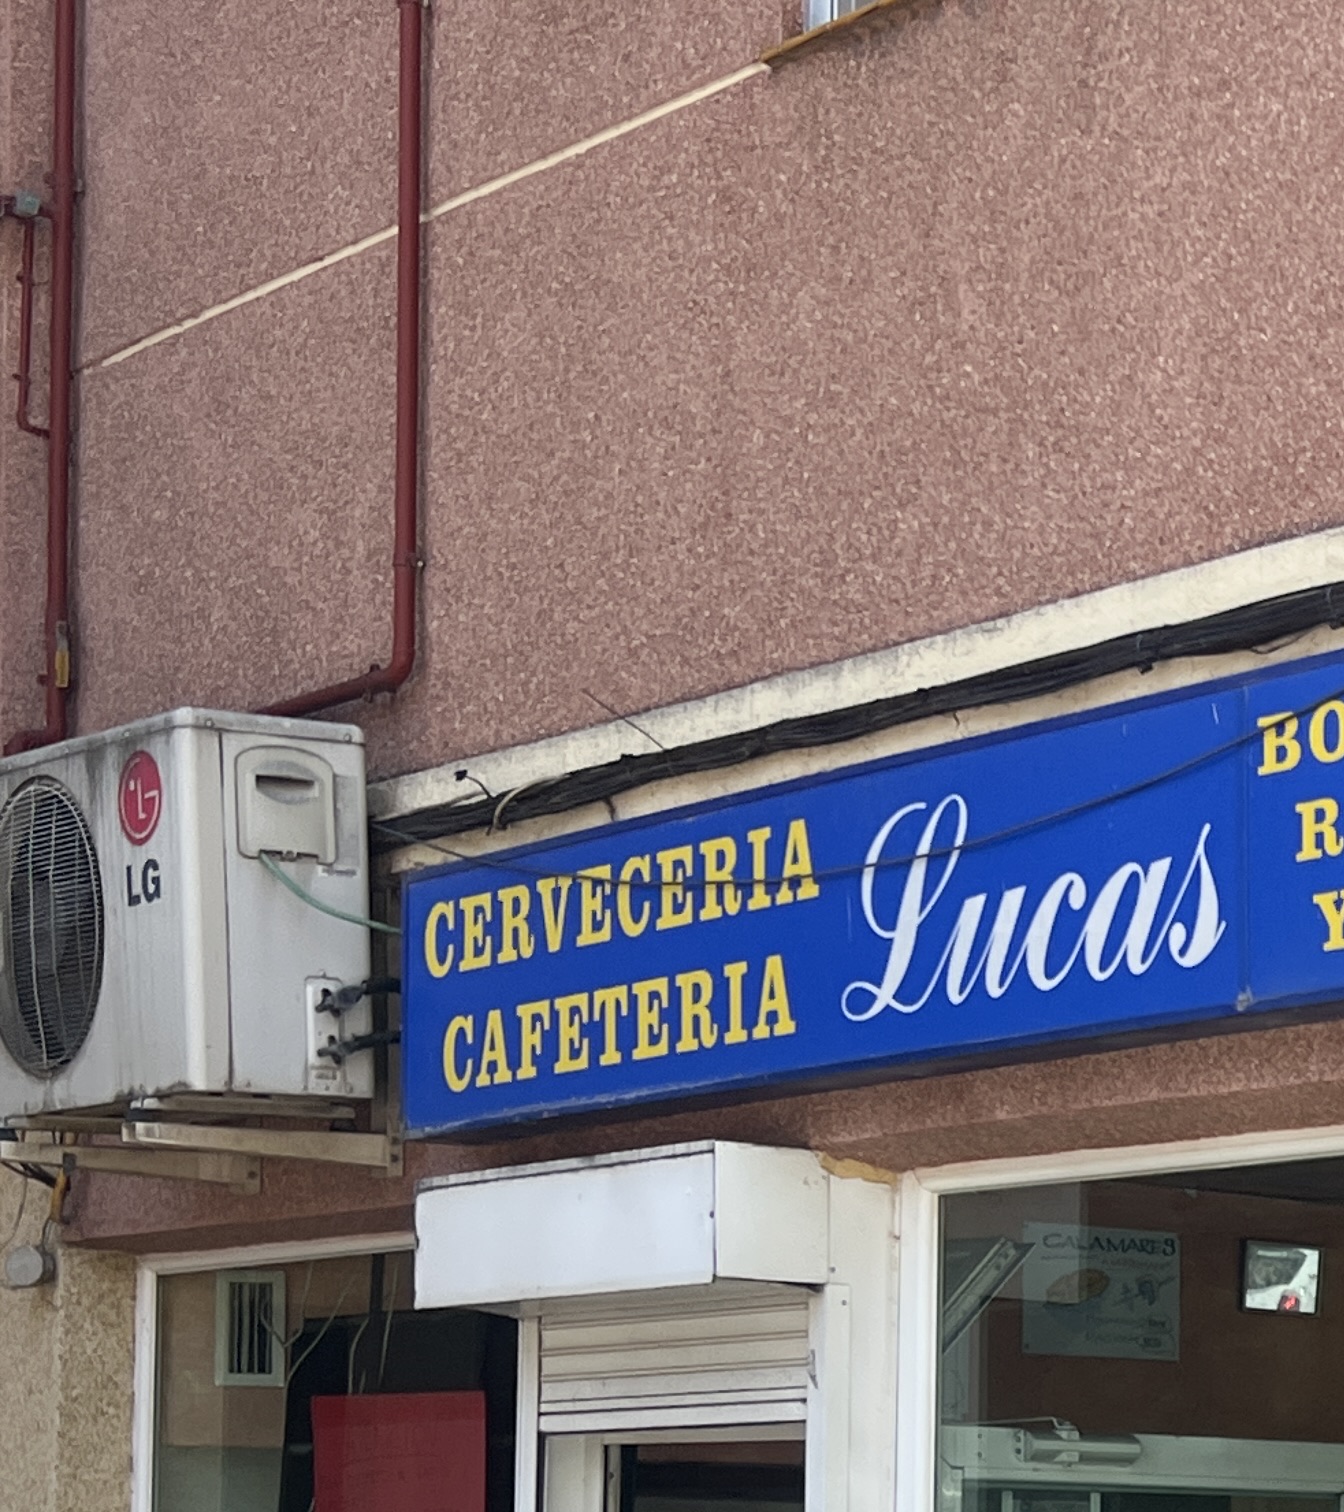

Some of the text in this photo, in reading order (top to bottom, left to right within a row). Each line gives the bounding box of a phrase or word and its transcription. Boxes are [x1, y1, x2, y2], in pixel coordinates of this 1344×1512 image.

[125, 858, 162, 907] LG
[424, 819, 820, 978] CERVECERIA
[842, 794, 1226, 1021] Lucas
[443, 954, 796, 1092] CAFETERIA
